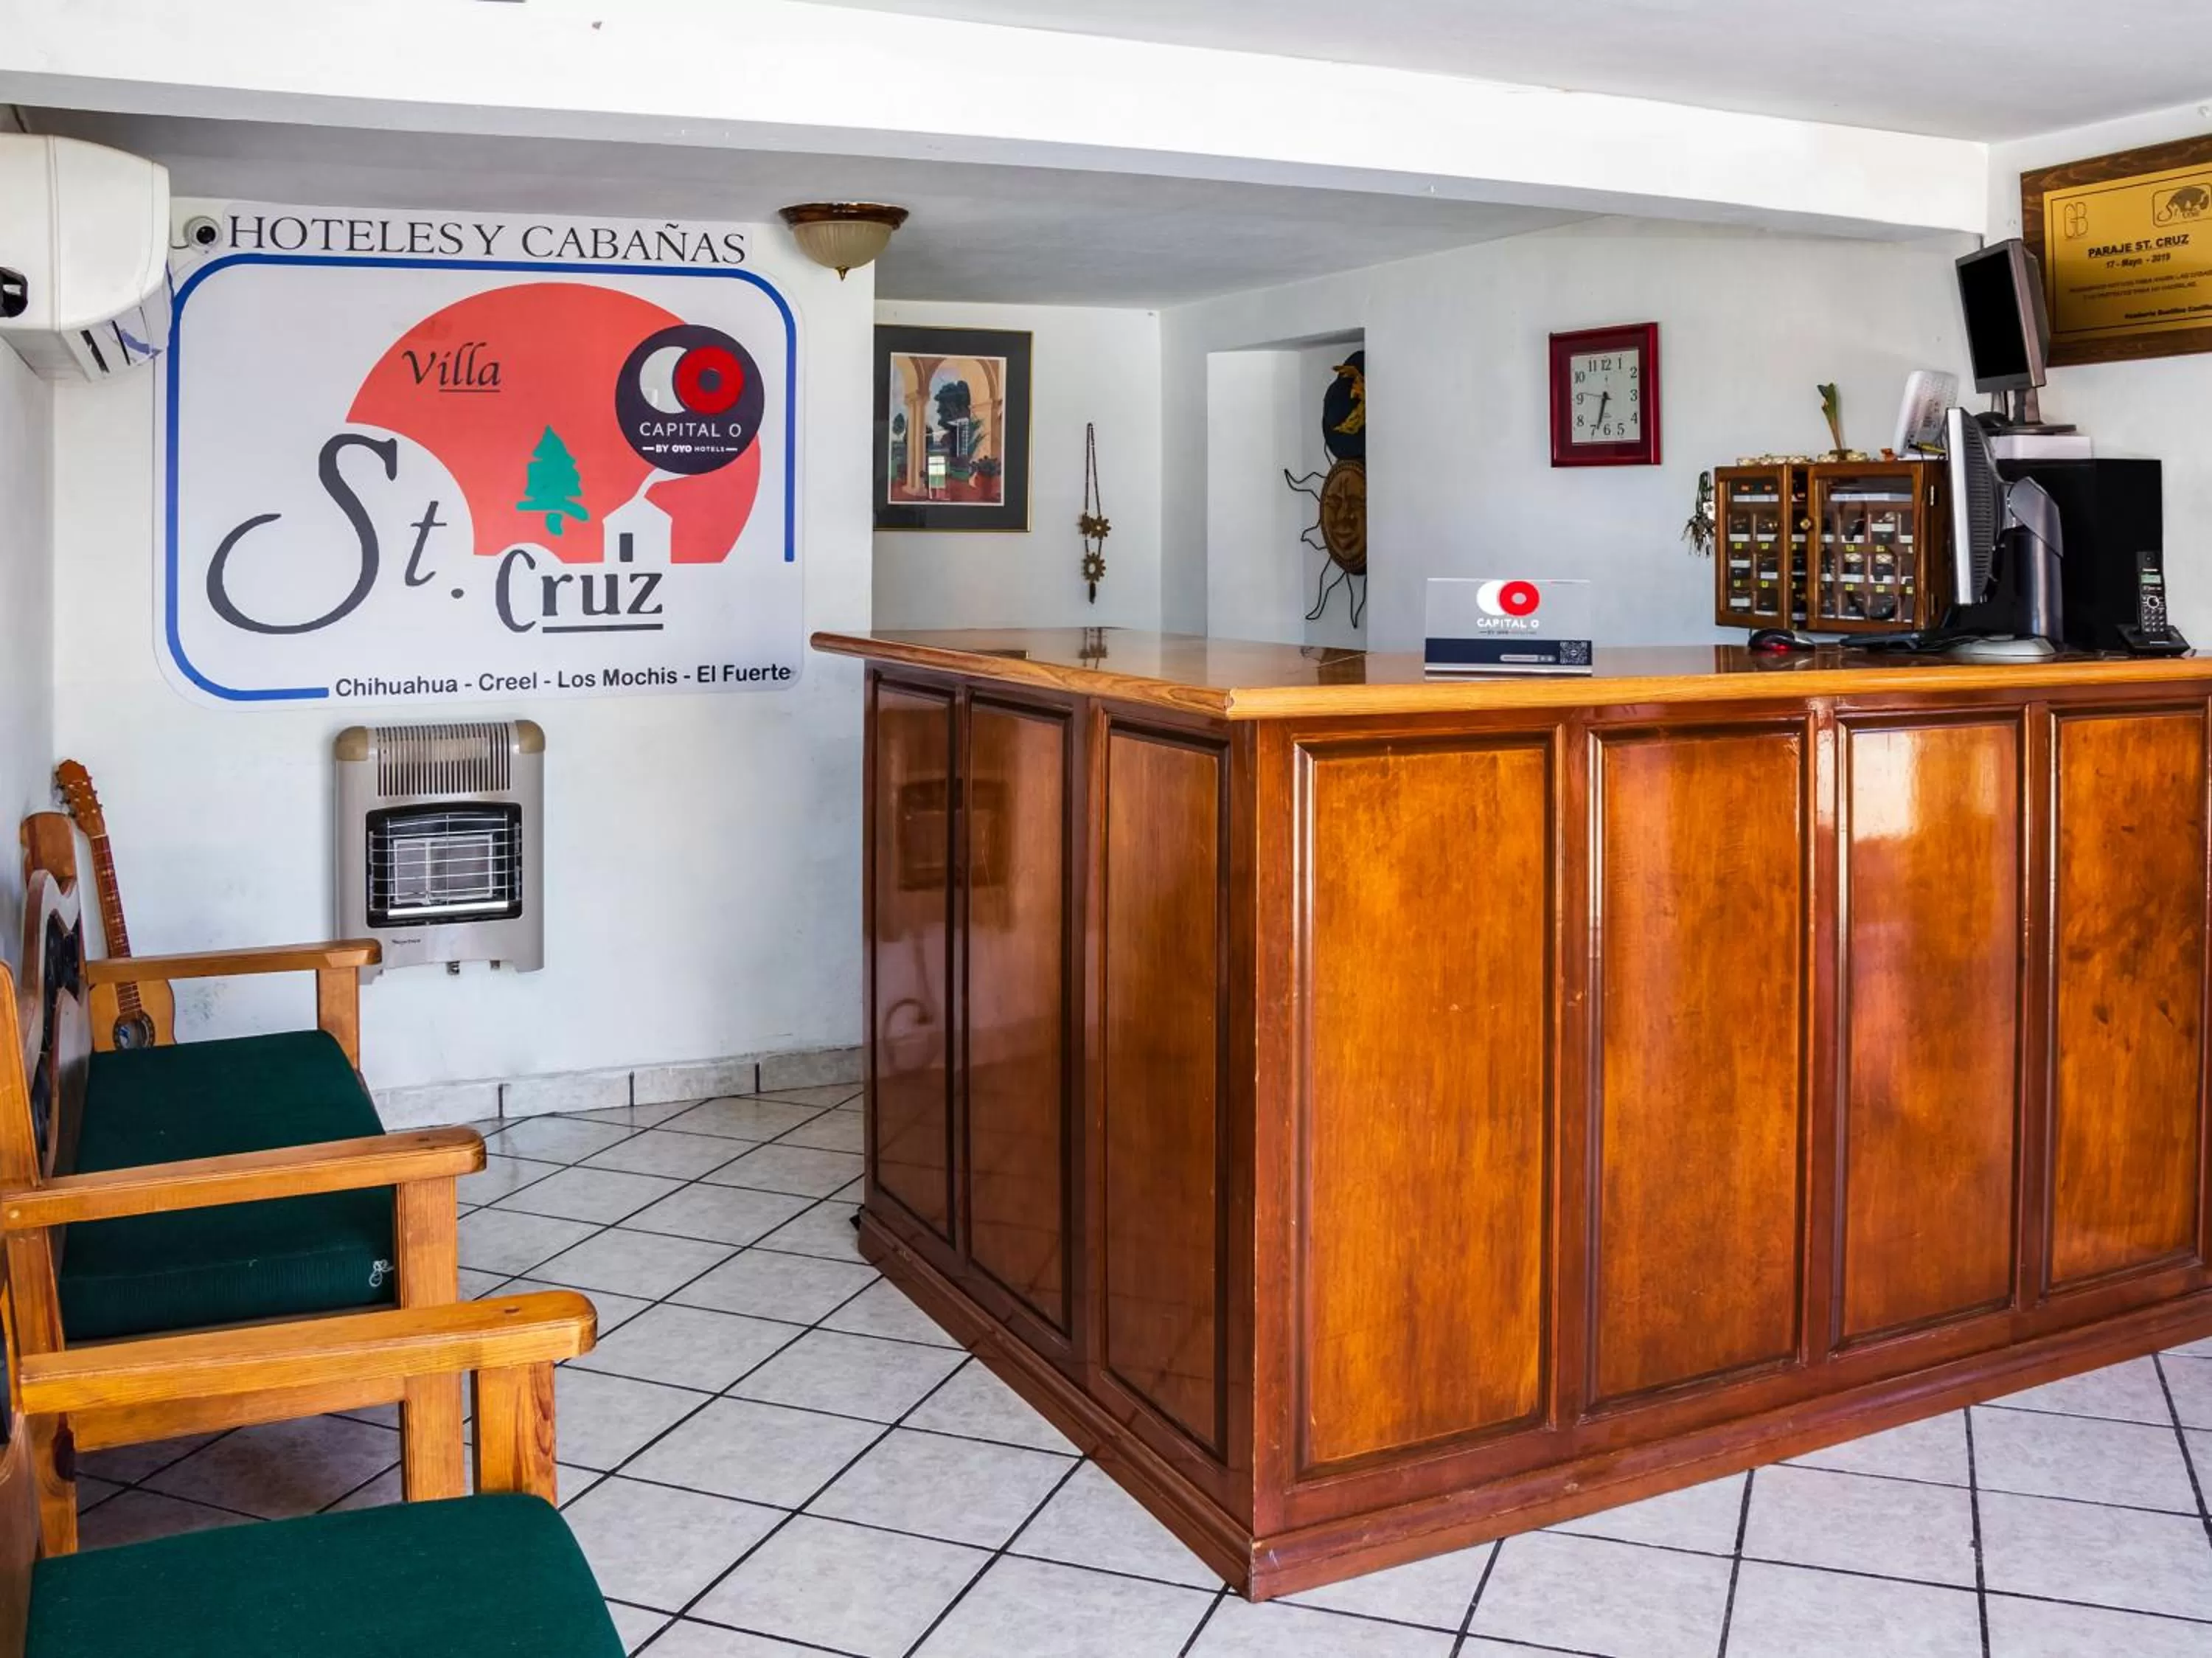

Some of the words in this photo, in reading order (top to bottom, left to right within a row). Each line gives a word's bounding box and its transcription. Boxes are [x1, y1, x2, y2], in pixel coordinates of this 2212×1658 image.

[229, 215, 464, 254] HOTELES
[473, 223, 506, 255] Y
[521, 223, 745, 264] CABAÑAS
[2087, 243, 2133, 258] PARAJE
[2135, 240, 2152, 251] ST.
[2156, 234, 2189, 248] CRUZ
[402, 342, 501, 392] Villa
[1587, 359, 1596, 372] 11
[1601, 358, 1611, 371] 12
[1618, 355, 1622, 370] 1
[1574, 371, 1585, 384] 10
[1630, 367, 1637, 378] 2
[1576, 395, 1584, 405] 9
[1630, 389, 1638, 401] 3
[1576, 415, 1585, 427] 8
[1630, 412, 1638, 424] 4
[639, 422, 721, 437] CAPITAL
[728, 423, 742, 437] O
[1590, 424, 1597, 436] 7
[1603, 423, 1611, 435] 6
[1617, 423, 1625, 435] 5
[655, 444, 669, 453] BY
[672, 445, 692, 453] OYO
[495, 549, 664, 633] Cruz
[1477, 618, 1527, 628] CAPITAL
[1531, 620, 1540, 628] O
[335, 676, 458, 697] Chihuahua
[479, 672, 538, 691] Creel
[558, 670, 596, 687] Los
[602, 667, 678, 686] Mochis
[697, 665, 716, 682] El
[723, 664, 791, 682] Fuerte
